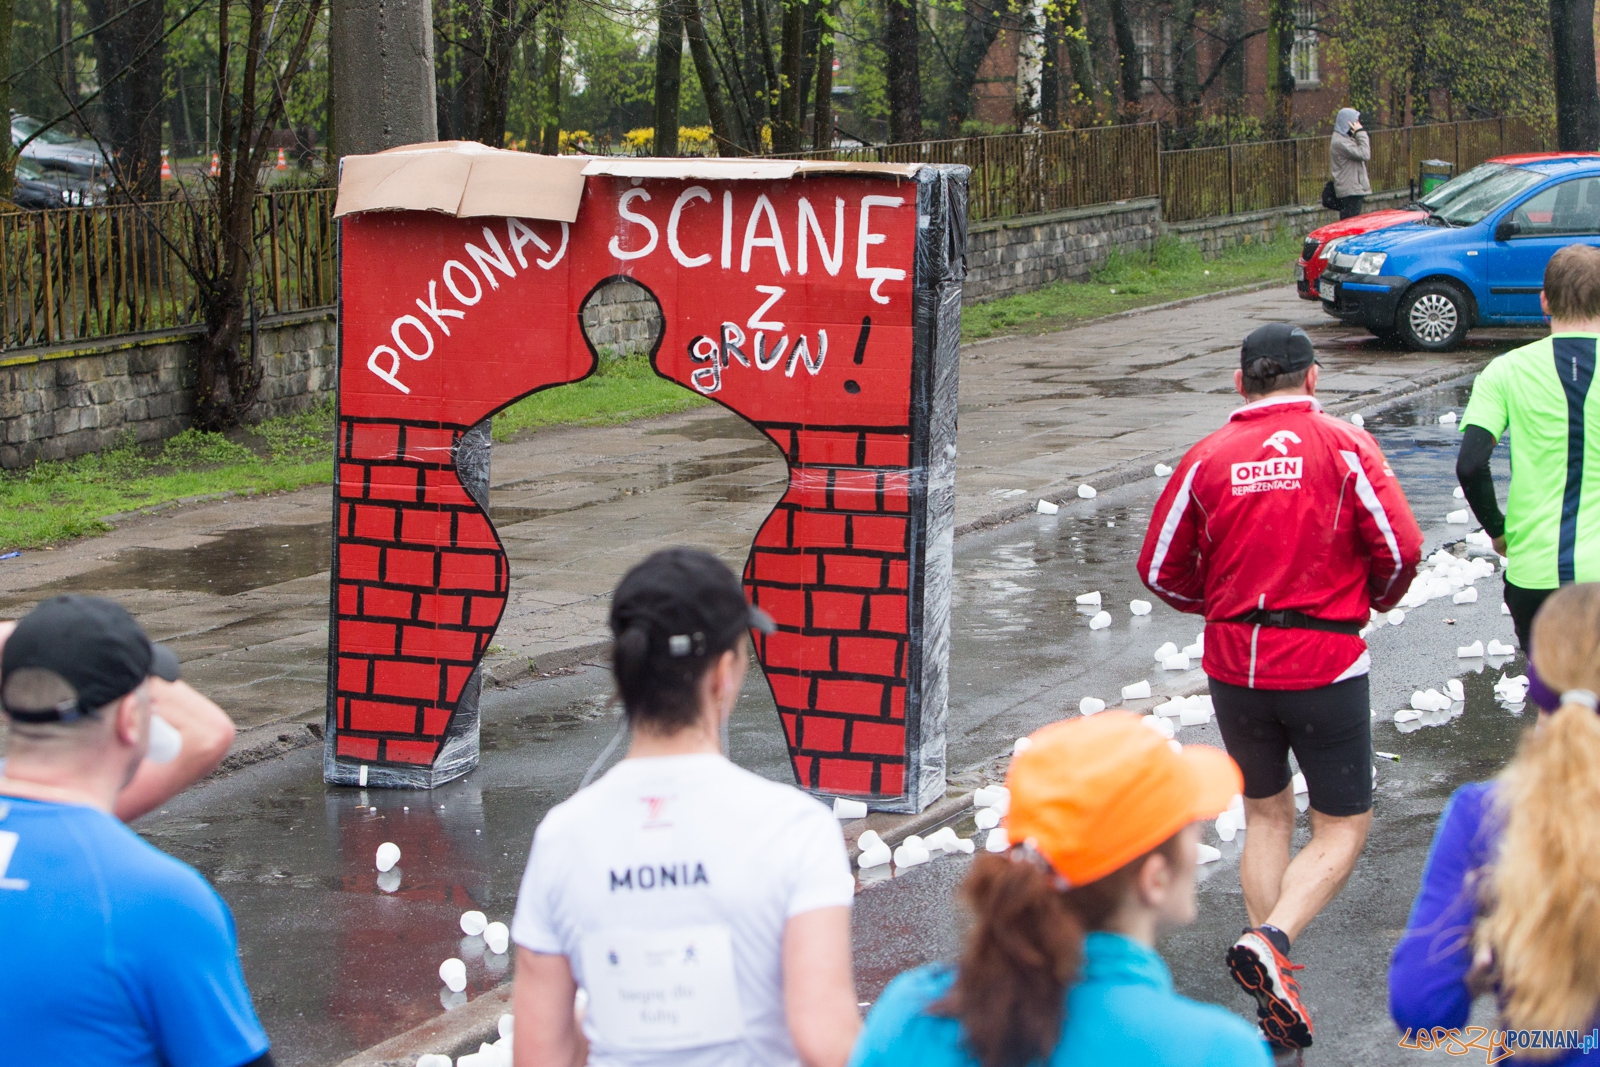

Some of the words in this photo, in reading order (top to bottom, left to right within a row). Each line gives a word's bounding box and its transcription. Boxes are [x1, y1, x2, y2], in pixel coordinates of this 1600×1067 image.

[366, 217, 570, 395] POKONAJ
[607, 178, 906, 304] ŚCIANĘ
[746, 284, 785, 331] Z
[1236, 461, 1297, 480] ORLEN
[1231, 480, 1301, 497] REPREZENTACJA
[609, 862, 709, 891] MONIA
